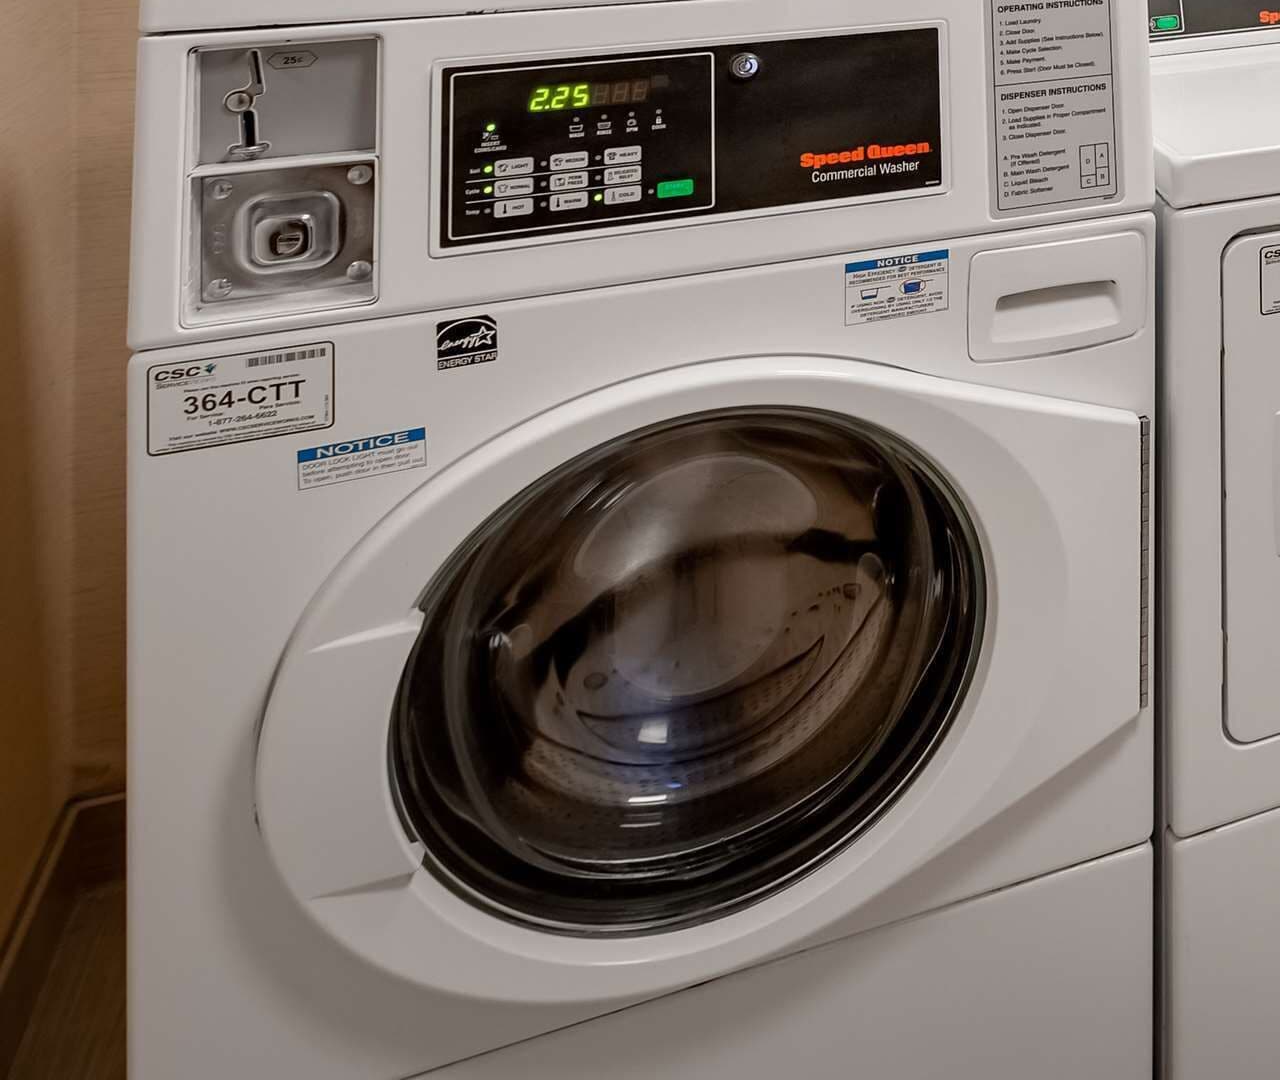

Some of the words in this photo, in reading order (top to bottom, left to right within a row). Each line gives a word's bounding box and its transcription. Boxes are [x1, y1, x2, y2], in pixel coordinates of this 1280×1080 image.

[997, 3, 1044, 13] OPERATING
[530, 85, 589, 110] 2.25
[1000, 89, 1047, 101] DISPENSER
[1048, 83, 1107, 97] INSTRUCTIONS
[800, 146, 865, 169] Speed
[867, 142, 930, 159] Queen
[811, 164, 877, 183] Commercial
[880, 161, 920, 175] Washer
[876, 255, 920, 268] NOTICE
[438, 355, 473, 369] ENERGY
[474, 352, 497, 363] STAR
[154, 366, 201, 381] CSC
[183, 379, 306, 415] 364-CTT
[316, 431, 409, 458] NOTICE
